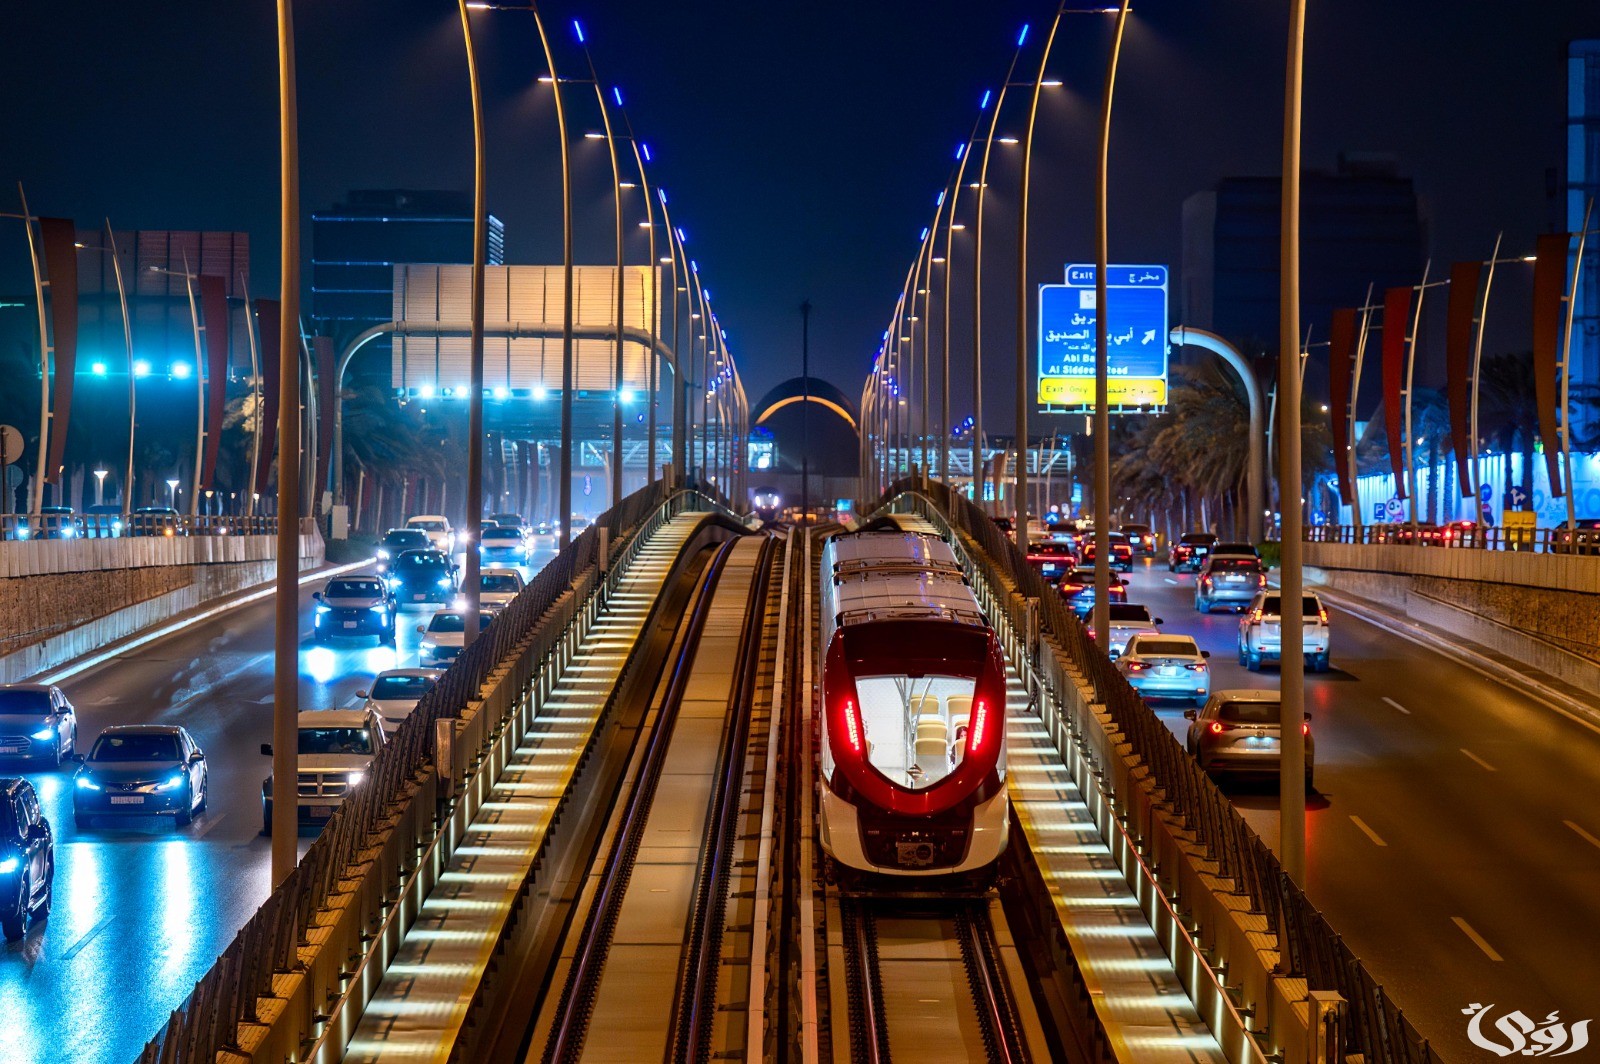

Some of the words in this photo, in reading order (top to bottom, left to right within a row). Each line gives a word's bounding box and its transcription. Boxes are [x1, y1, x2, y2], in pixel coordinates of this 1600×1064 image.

[1072, 271, 1094, 279] Exit
[1128, 272, 1160, 283] مخرج
[1071, 313, 1097, 325] ريق
[1045, 329, 1090, 342] الصديق
[1063, 354, 1080, 362] Abi
[1082, 354, 1111, 362] Bar
[1049, 365, 1060, 374] Al
[1063, 365, 1097, 374] Siddee
[1069, 386, 1088, 394] Only
[1376, 504, 1384, 514] P
